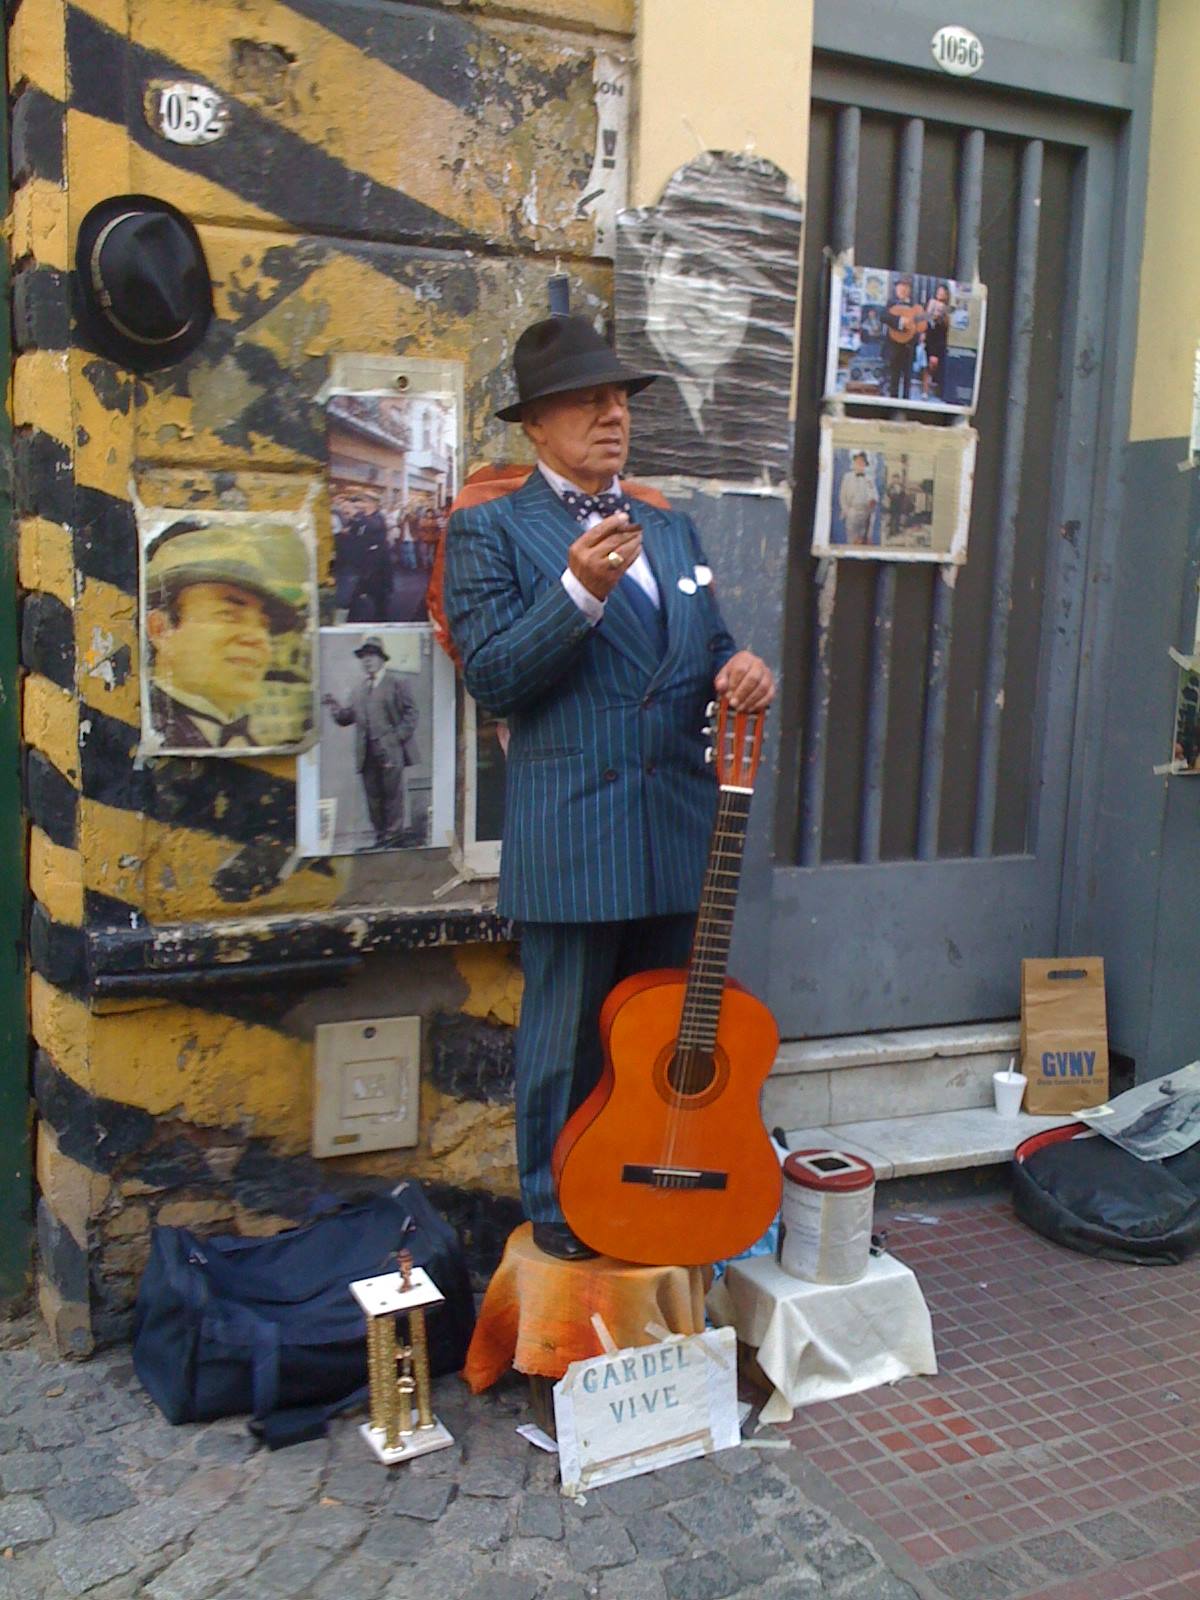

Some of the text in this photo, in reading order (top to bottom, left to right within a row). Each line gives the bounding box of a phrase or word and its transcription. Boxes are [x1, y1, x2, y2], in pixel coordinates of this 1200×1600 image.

[940, 34, 979, 69] 1056
[1042, 1051, 1096, 1077] GVNY
[583, 1345, 690, 1394] GARDEL
[609, 1384, 680, 1424] VIVE
